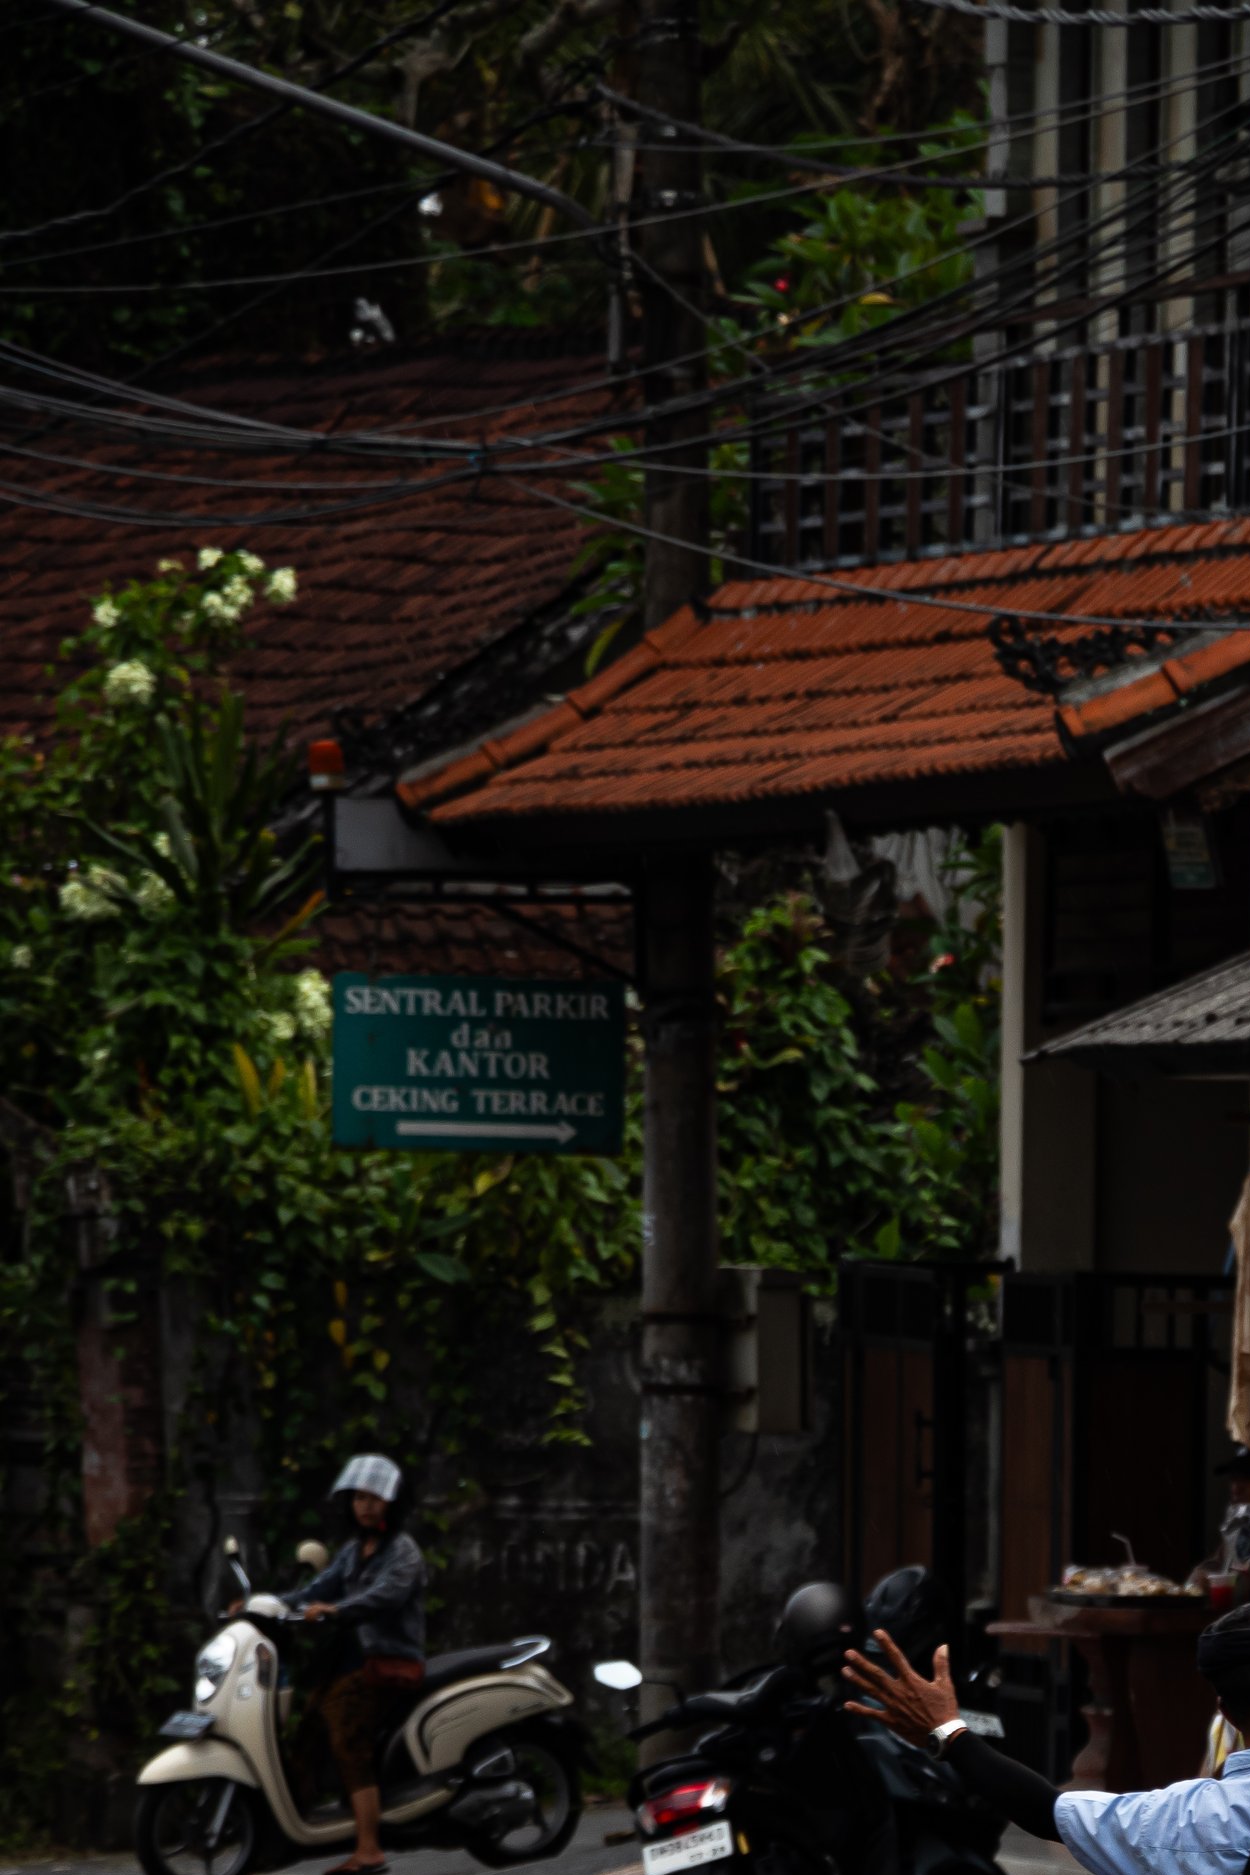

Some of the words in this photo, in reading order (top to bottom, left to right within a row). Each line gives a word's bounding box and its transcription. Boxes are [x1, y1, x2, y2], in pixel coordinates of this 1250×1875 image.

[344, 985, 486, 1017] SENTRAL
[495, 992, 610, 1020] PARKIR
[450, 1022, 513, 1049] dan
[406, 1049, 550, 1079] KANTOR
[351, 1084, 460, 1113] CEKING
[471, 1089, 605, 1117] TERRACE
